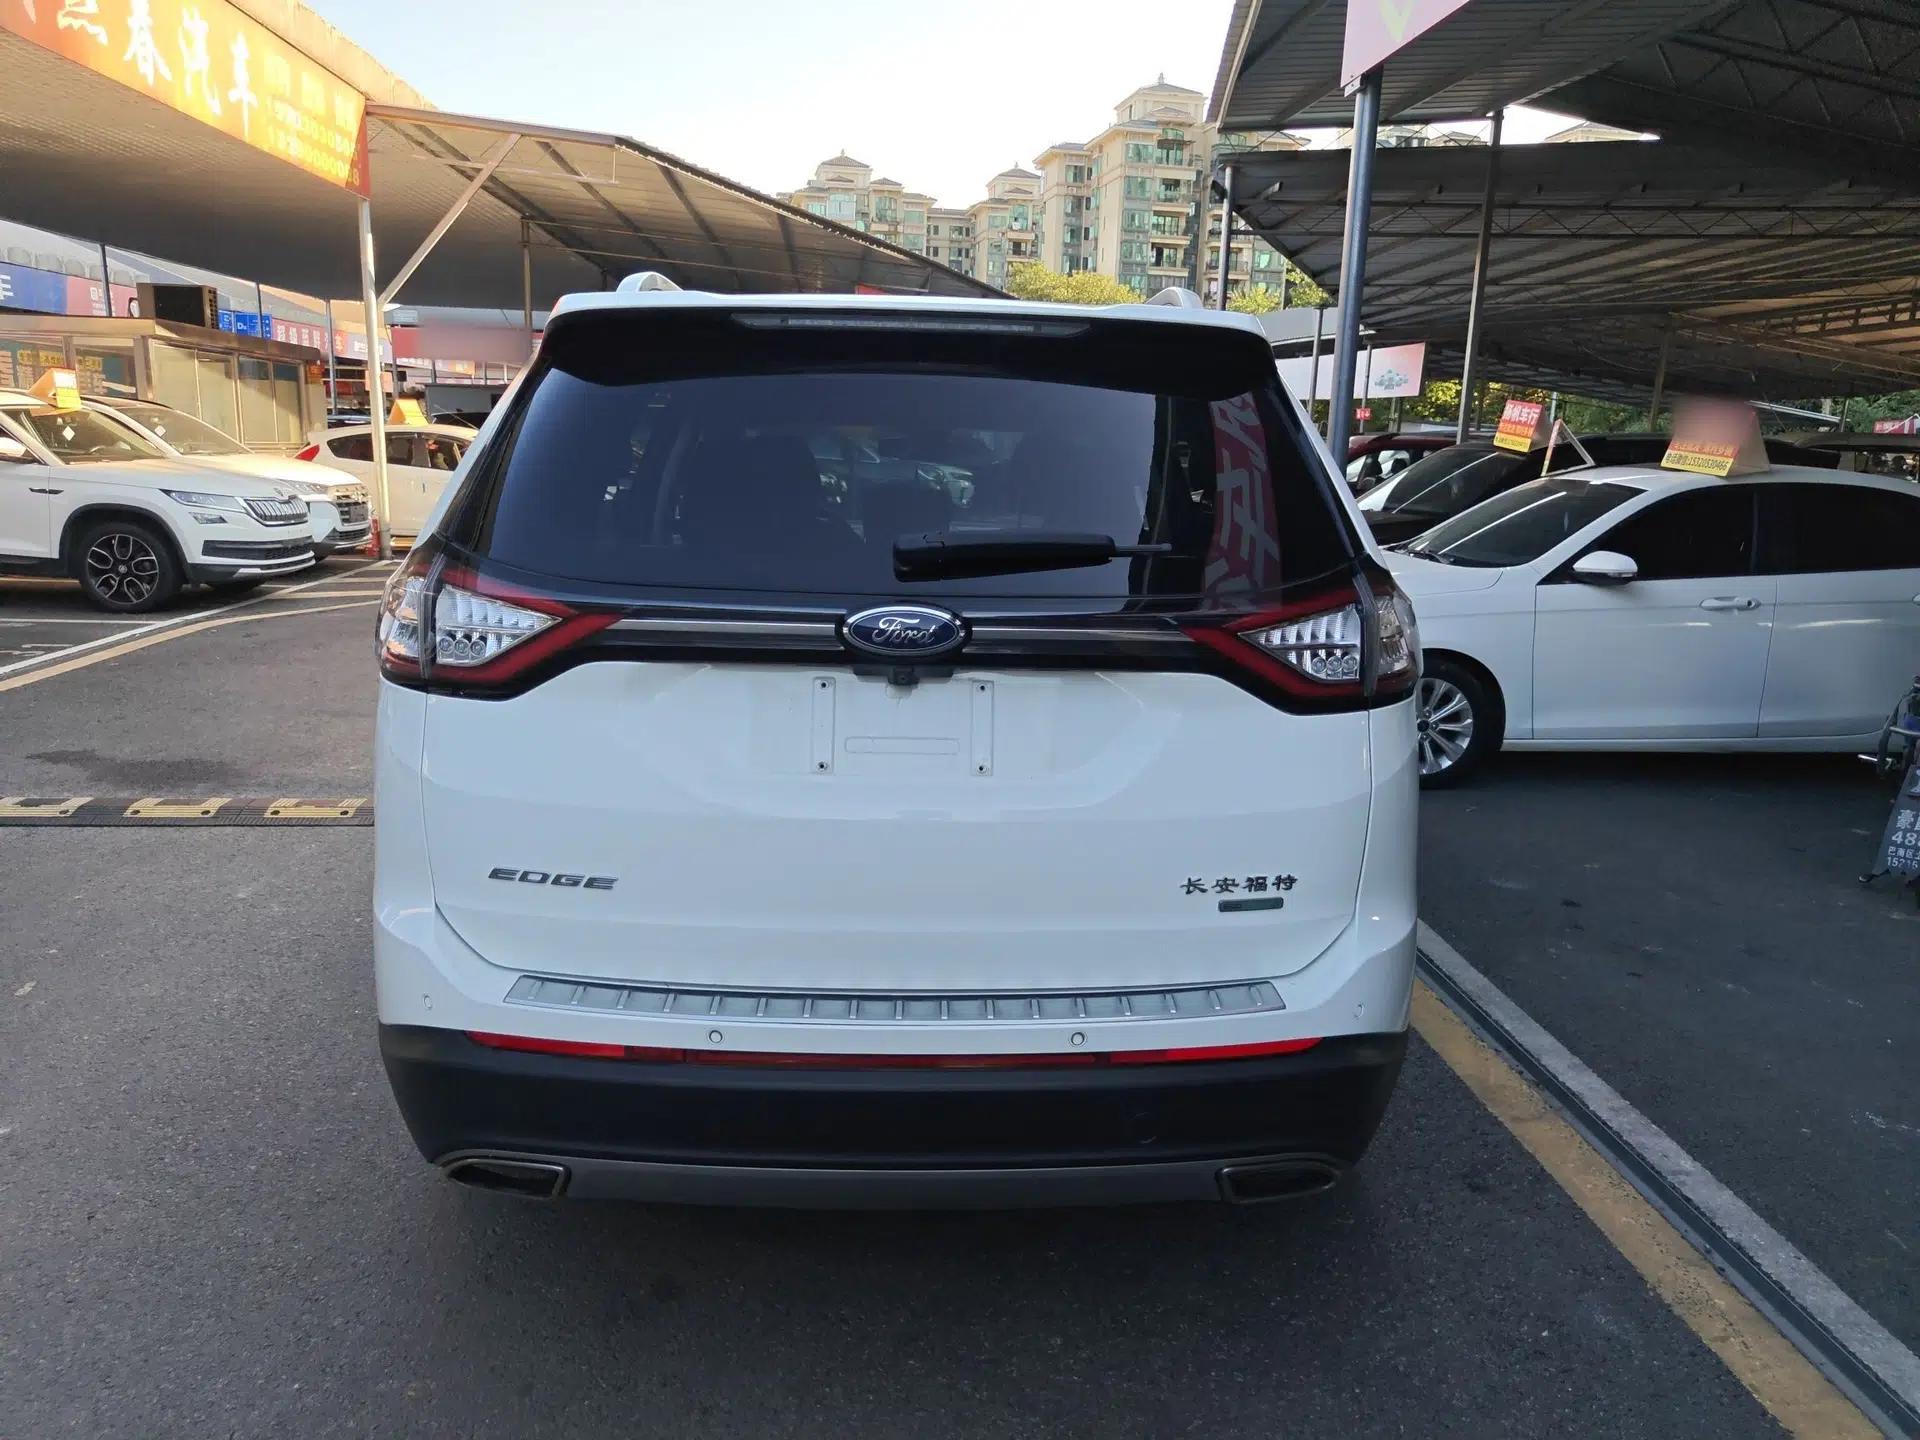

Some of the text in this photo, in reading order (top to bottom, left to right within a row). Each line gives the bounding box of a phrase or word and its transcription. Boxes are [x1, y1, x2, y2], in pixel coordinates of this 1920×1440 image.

[871, 616, 936, 643] Ford
[1891, 831, 1920, 846] 48
[488, 867, 619, 890] EDGE
[1180, 874, 1298, 894] 长安福特
